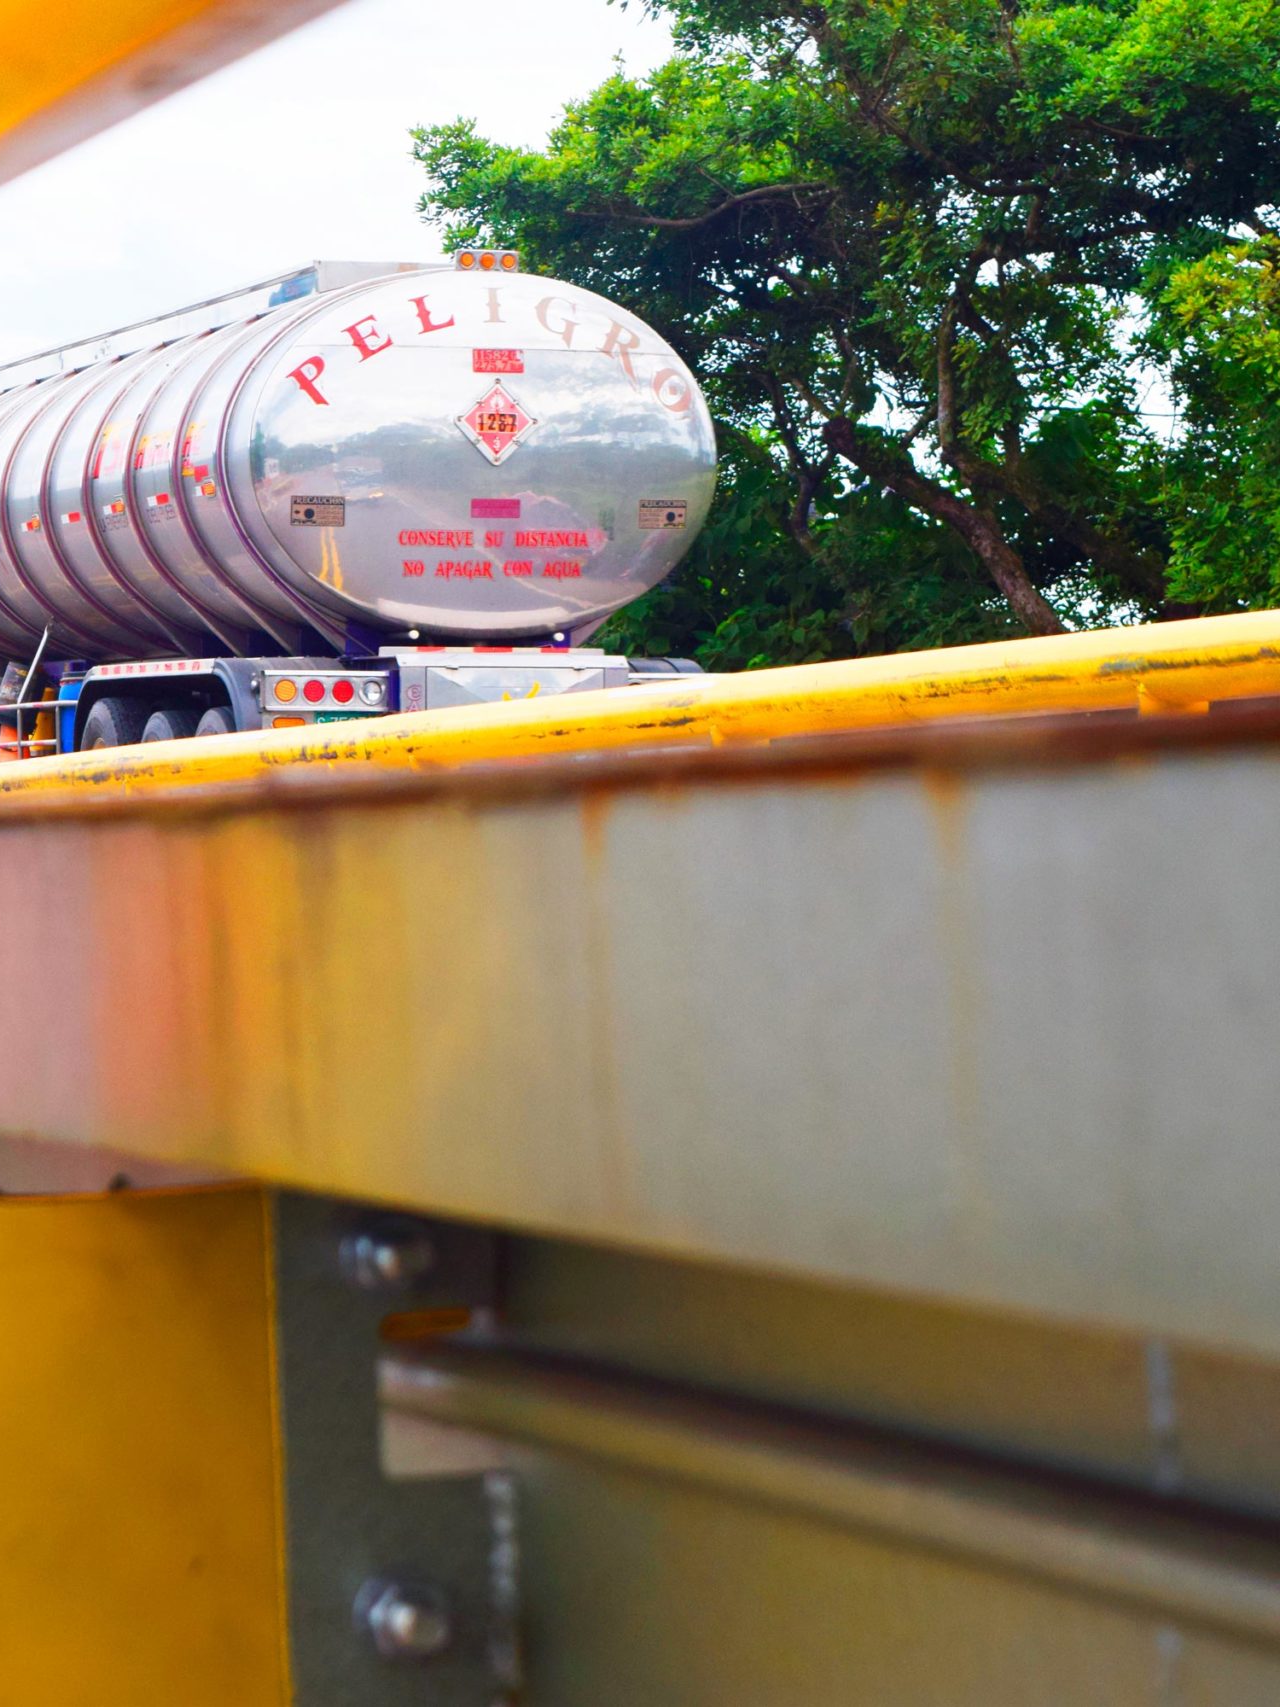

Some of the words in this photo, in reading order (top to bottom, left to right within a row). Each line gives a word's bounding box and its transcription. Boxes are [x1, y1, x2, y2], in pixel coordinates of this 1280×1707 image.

[286, 286, 694, 414] PELIGRO
[493, 439, 502, 450] 3
[399, 530, 473, 549] CONSERVE
[485, 531, 504, 547] SU
[516, 530, 588, 547] DISTANCIA
[403, 561, 424, 578] NO
[435, 561, 493, 579] APAGAR
[503, 560, 533, 577] CON
[543, 561, 581, 579] AGUA
